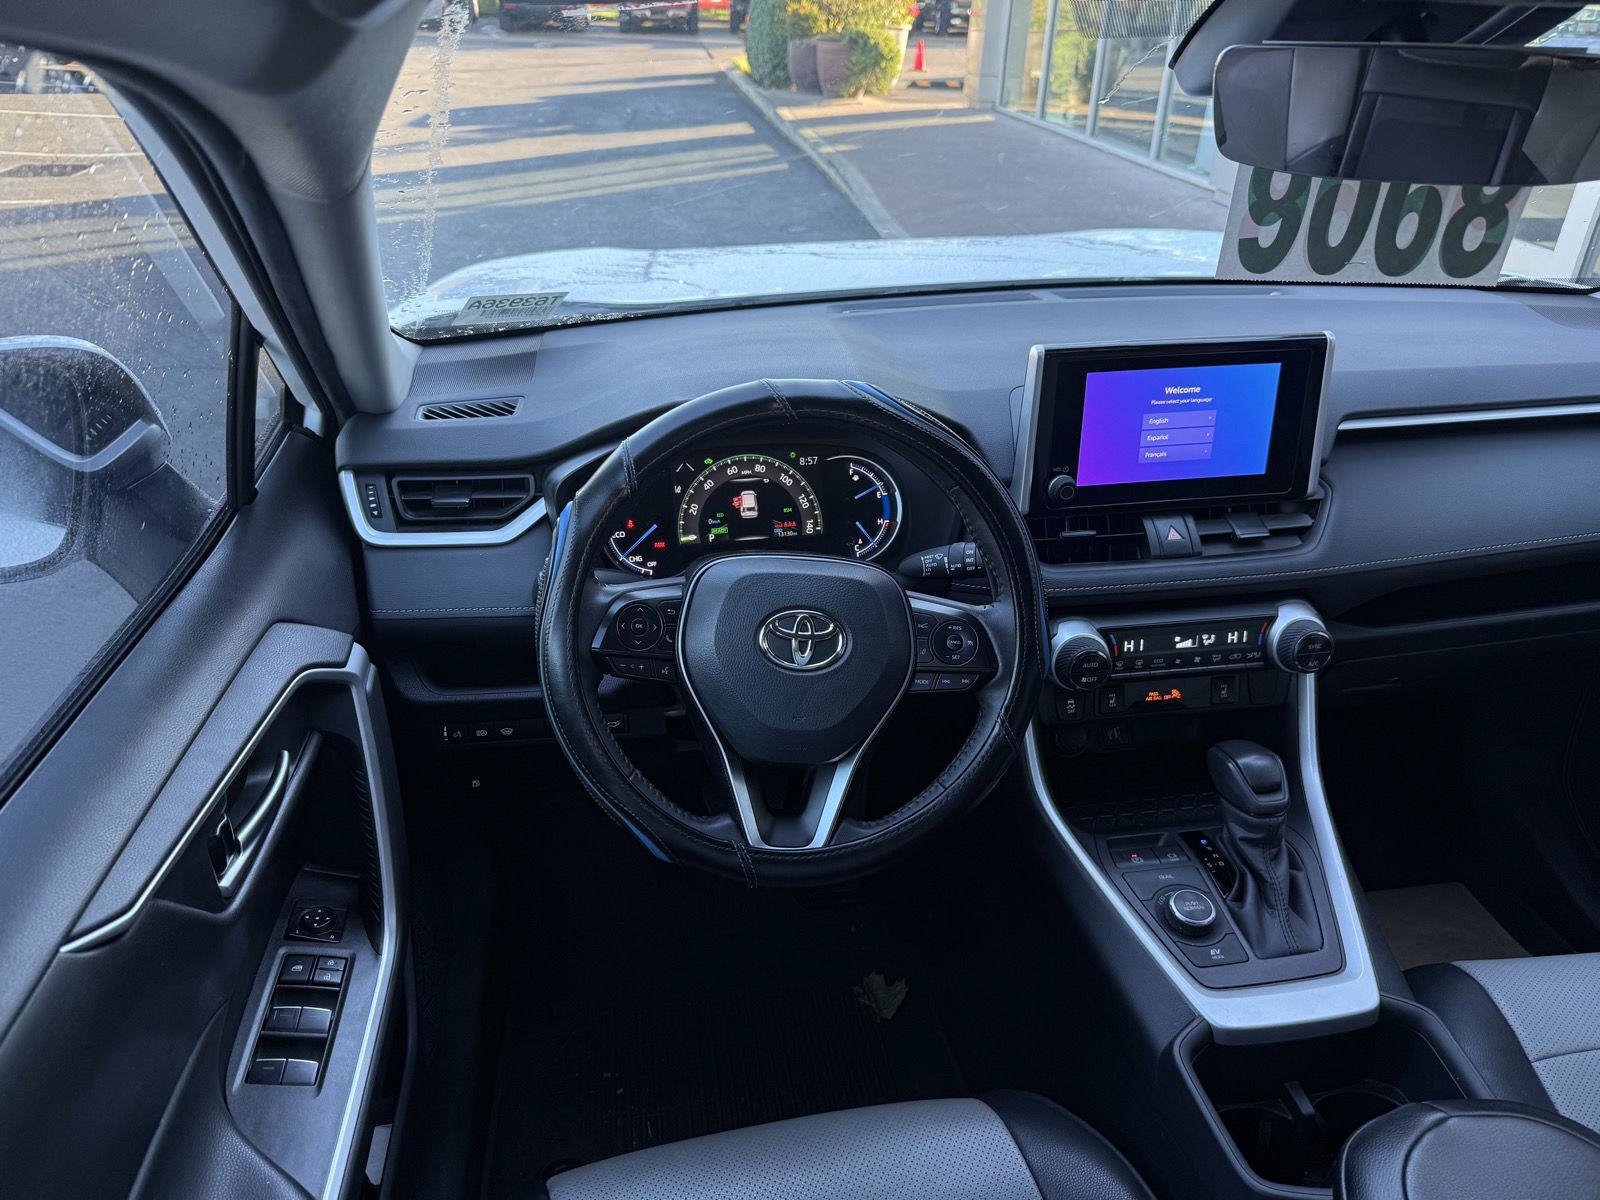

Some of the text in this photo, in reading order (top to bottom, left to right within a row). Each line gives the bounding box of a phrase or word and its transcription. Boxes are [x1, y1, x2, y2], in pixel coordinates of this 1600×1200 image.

[1238, 167, 1519, 279] 9068
[1164, 386, 1201, 394] Welcome
[1149, 417, 1169, 425] English
[1147, 434, 1169, 442] Español
[1145, 450, 1167, 458] Français
[799, 456, 818, 466] 8:57
[726, 465, 739, 476] 60
[754, 464, 766, 473] 80
[849, 468, 854, 476] F
[779, 472, 793, 487] 100
[703, 479, 715, 491] 40
[798, 493, 810, 509] 120
[689, 503, 699, 516] 20
[805, 518, 814, 534] 140
[708, 533, 715, 542] P
[854, 544, 860, 552] C
[628, 555, 643, 563] CHG
[1227, 630, 1248, 643] HI
[1123, 639, 1144, 652] HI
